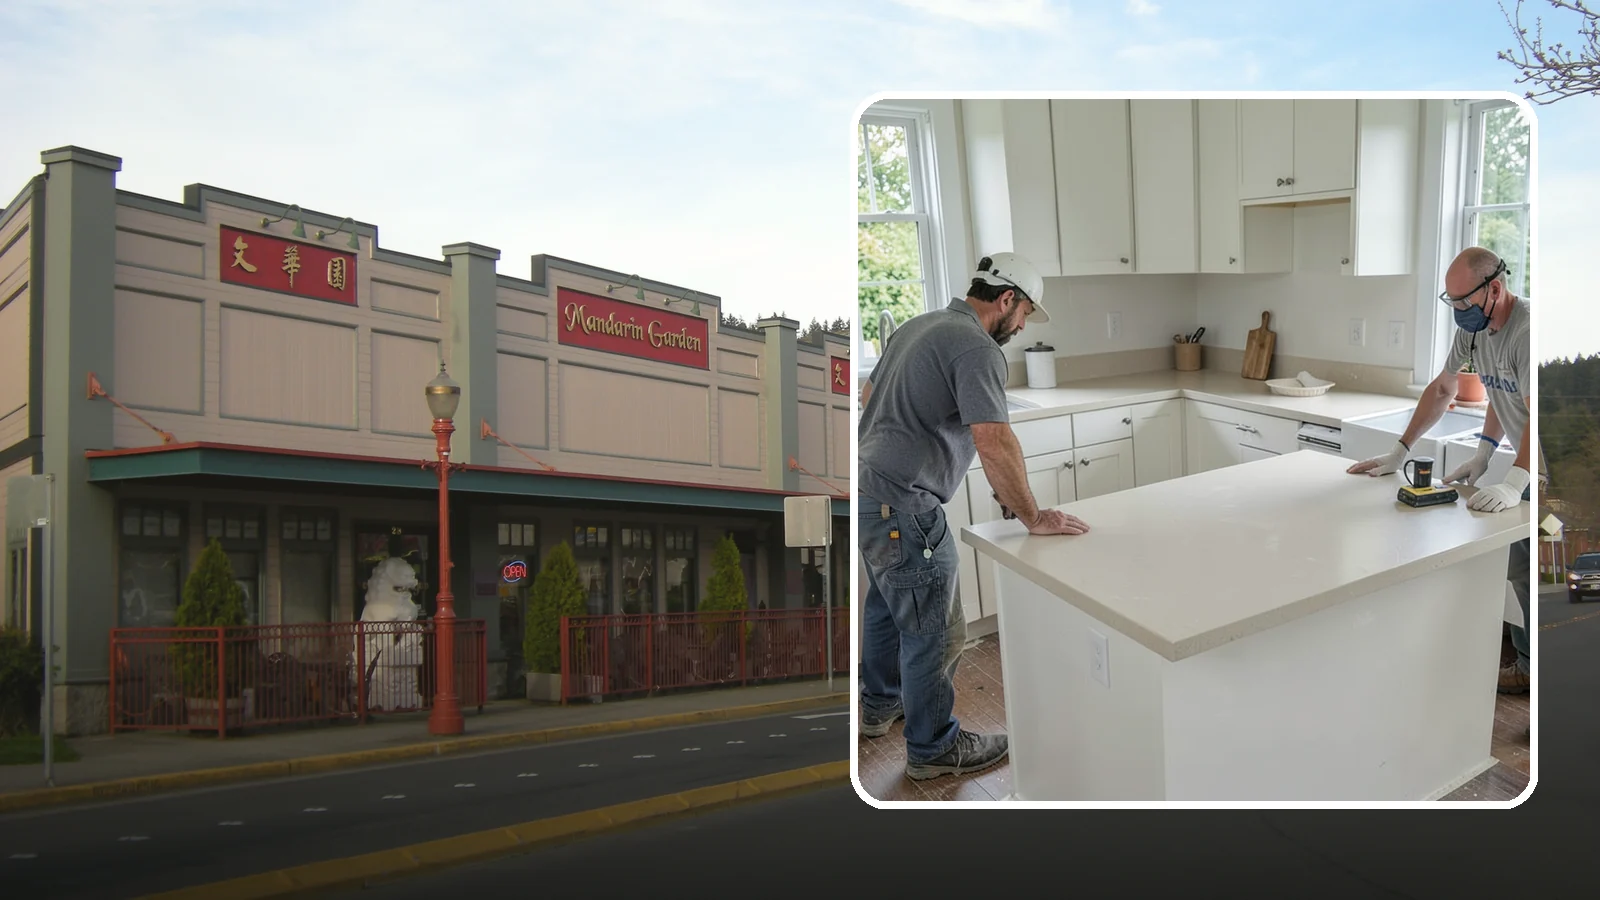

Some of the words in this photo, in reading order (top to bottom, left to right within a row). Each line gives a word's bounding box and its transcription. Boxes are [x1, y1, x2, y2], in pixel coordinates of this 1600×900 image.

[231, 235, 346, 290] 文華園
[564, 302, 644, 340] Mandarin
[647, 320, 701, 352] Garden
[503, 565, 527, 578] OPEN
